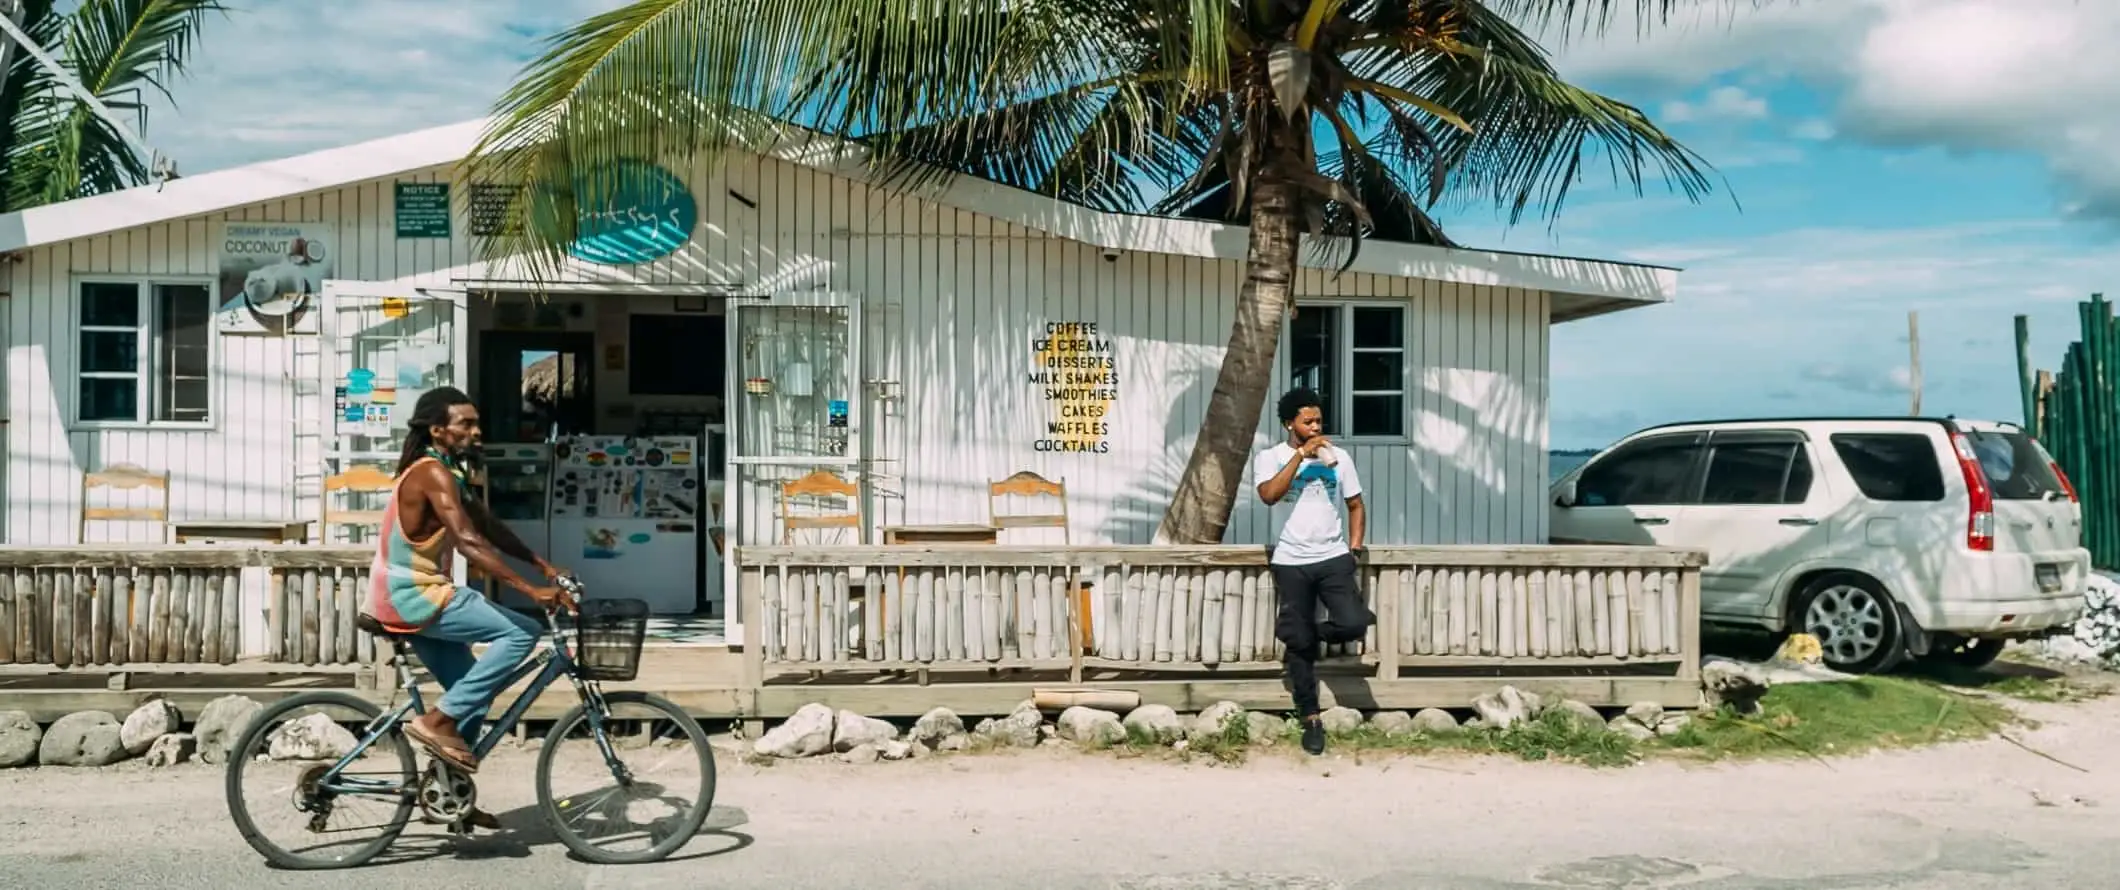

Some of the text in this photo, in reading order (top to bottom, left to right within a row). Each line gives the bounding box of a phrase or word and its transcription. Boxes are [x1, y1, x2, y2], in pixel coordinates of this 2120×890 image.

[402, 186, 440, 195] NOTICE
[225, 240, 289, 254] COCONUT
[1046, 322, 1097, 335] COFFEE
[1032, 339, 1110, 352] ICE CREAM
[1028, 373, 1119, 385] MILK SHAKES
[1045, 388, 1117, 401] SMOOTHIES
[1062, 405, 1104, 417] CAKES
[1047, 421, 1109, 435] WAFFLES
[1034, 439, 1109, 453] COCKTAILS
